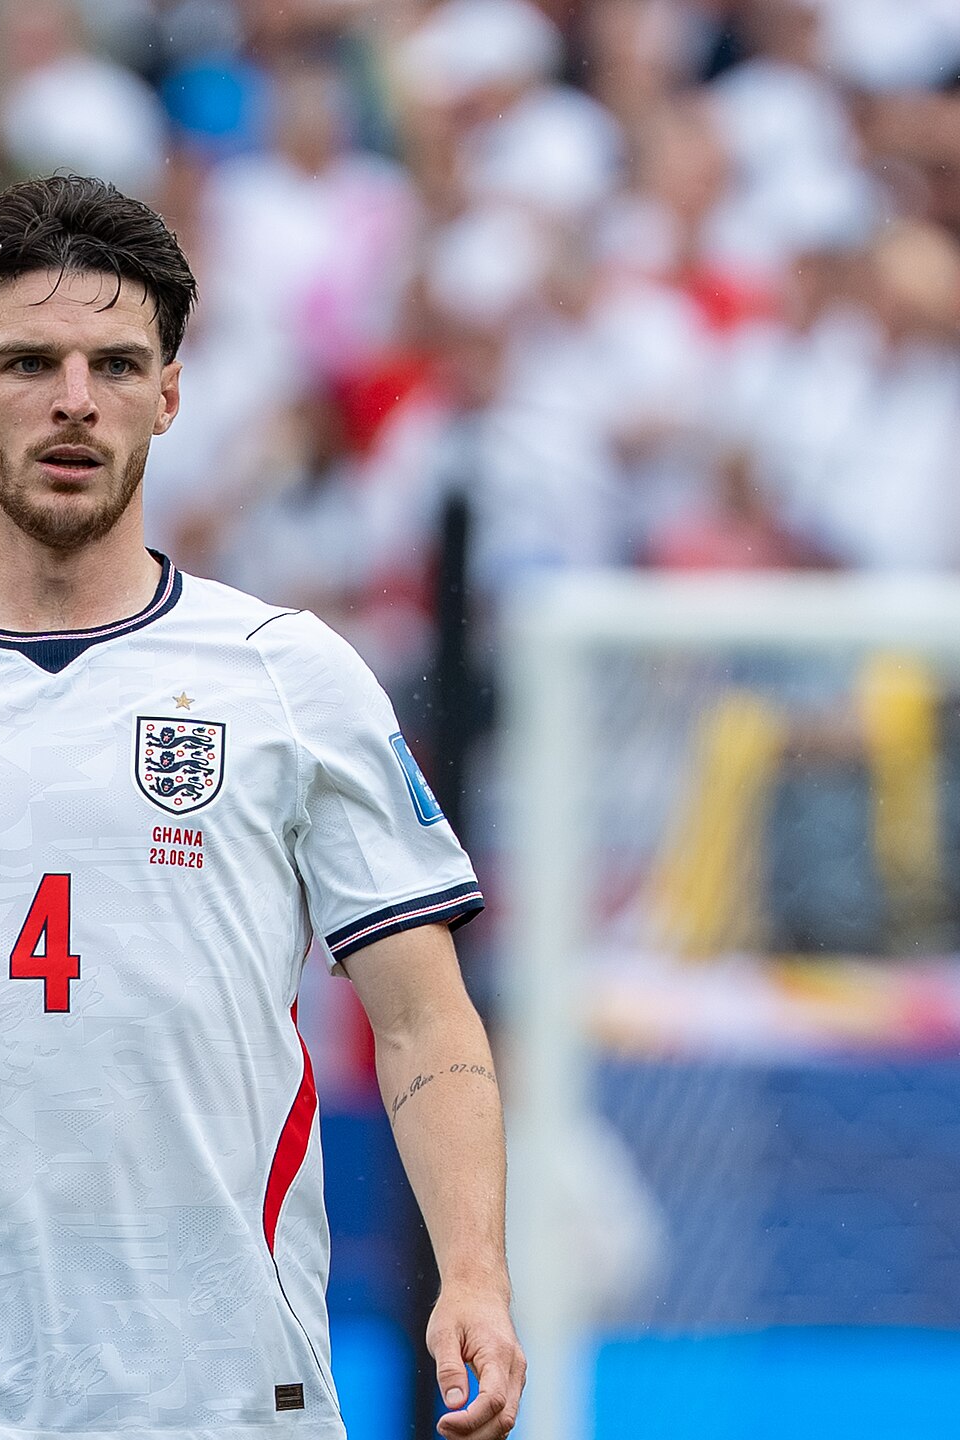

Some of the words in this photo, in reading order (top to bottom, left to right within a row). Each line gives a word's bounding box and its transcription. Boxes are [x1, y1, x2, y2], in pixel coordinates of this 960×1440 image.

[152, 826, 203, 847] GHANA
[149, 848, 203, 869] 23.06.26
[9, 873, 81, 1013] 4
